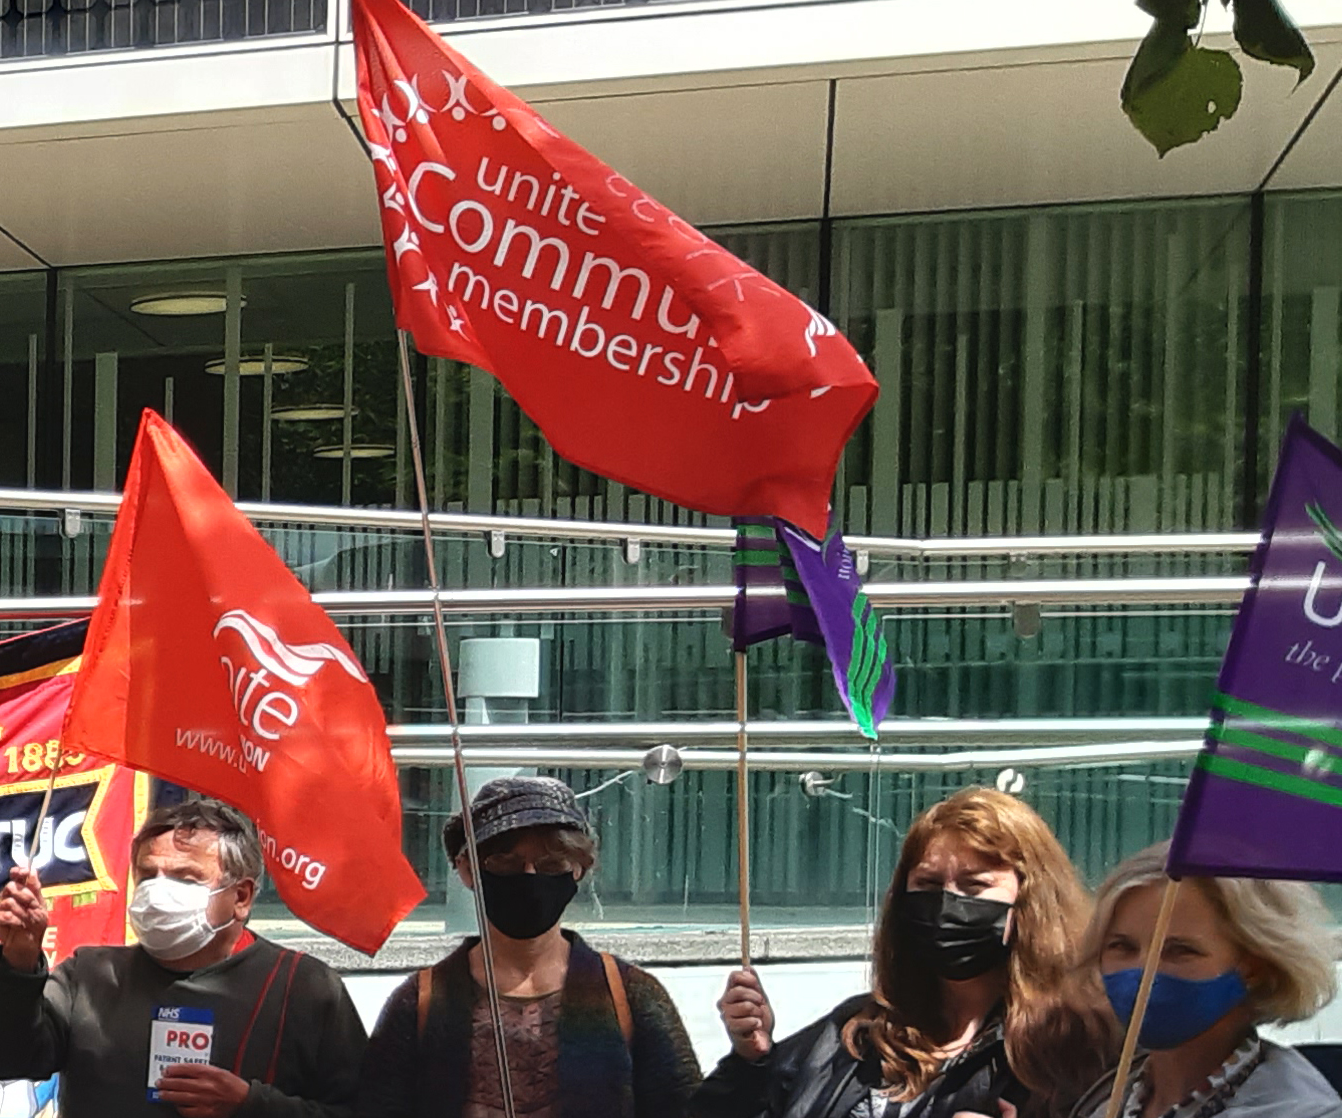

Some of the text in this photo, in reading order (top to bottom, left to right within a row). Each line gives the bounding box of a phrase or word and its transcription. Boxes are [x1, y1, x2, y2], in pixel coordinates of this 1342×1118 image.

[476, 156, 607, 236] unite
[407, 161, 704, 343] Commu
[1284, 641, 1329, 672] the
[158, 1007, 180, 1018] NHS
[166, 1030, 209, 1050] PRO
